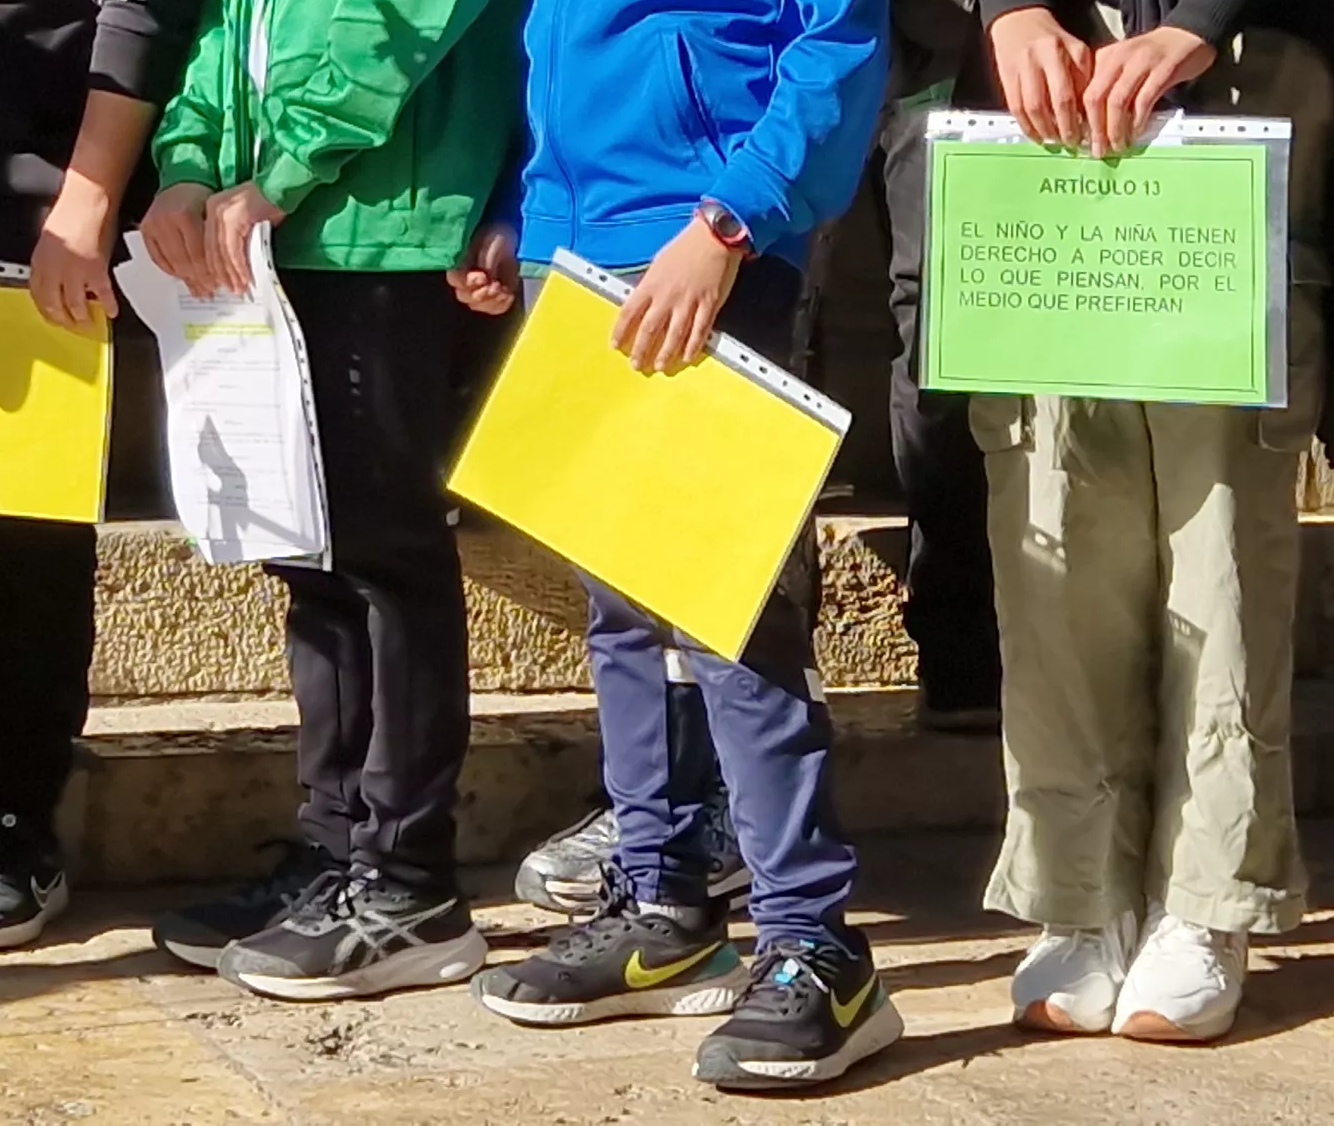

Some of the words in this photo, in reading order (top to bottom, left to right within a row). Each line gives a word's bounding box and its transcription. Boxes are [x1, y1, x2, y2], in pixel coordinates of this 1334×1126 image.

[1039, 174, 1137, 197] ARTÍCULO
[1143, 179, 1162, 197] 13
[961, 221, 984, 239] EL
[996, 219, 1045, 241] NIÑO
[1057, 224, 1069, 241] Y
[1080, 225, 1104, 242] LA
[1115, 222, 1157, 244] NIÑA
[1168, 227, 1237, 245] TIENEN
[960, 246, 1057, 264] DERECHO
[1071, 247, 1085, 265] A
[1099, 248, 1164, 267] PODER
[1178, 250, 1237, 269] DECIR
[960, 267, 985, 285] LO
[1000, 268, 1041, 287] QUE
[1160, 273, 1200, 291] POR
[1214, 274, 1237, 292] EL
[959, 291, 1022, 310] MEDIO
[1028, 293, 1069, 312] QUE
[1075, 294, 1184, 314] PREFIERAN
